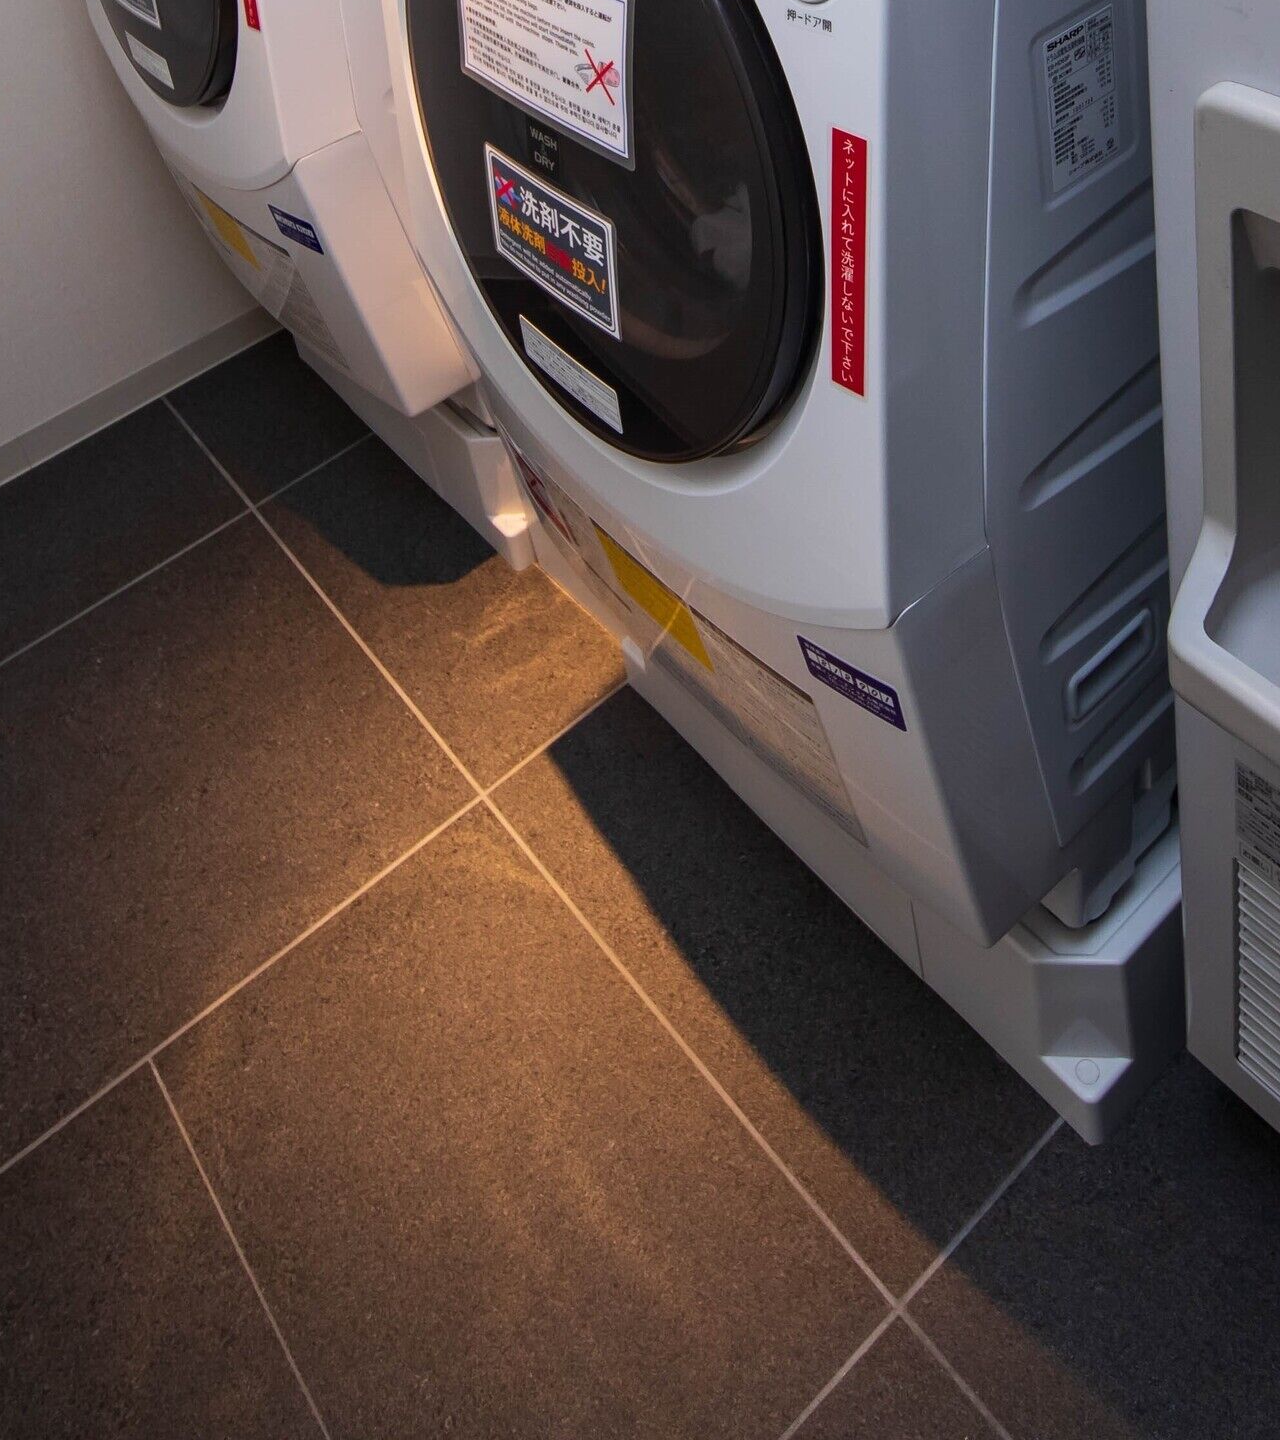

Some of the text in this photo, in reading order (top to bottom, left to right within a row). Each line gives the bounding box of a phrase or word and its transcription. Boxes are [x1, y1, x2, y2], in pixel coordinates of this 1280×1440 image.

[1047, 24, 1084, 53] SHARP
[530, 126, 558, 151] WASH
[534, 150, 556, 172] DRY
[520, 185, 604, 267] 洗剤不要
[840, 139, 854, 383] ネットに入れて洗濯しないで下さい
